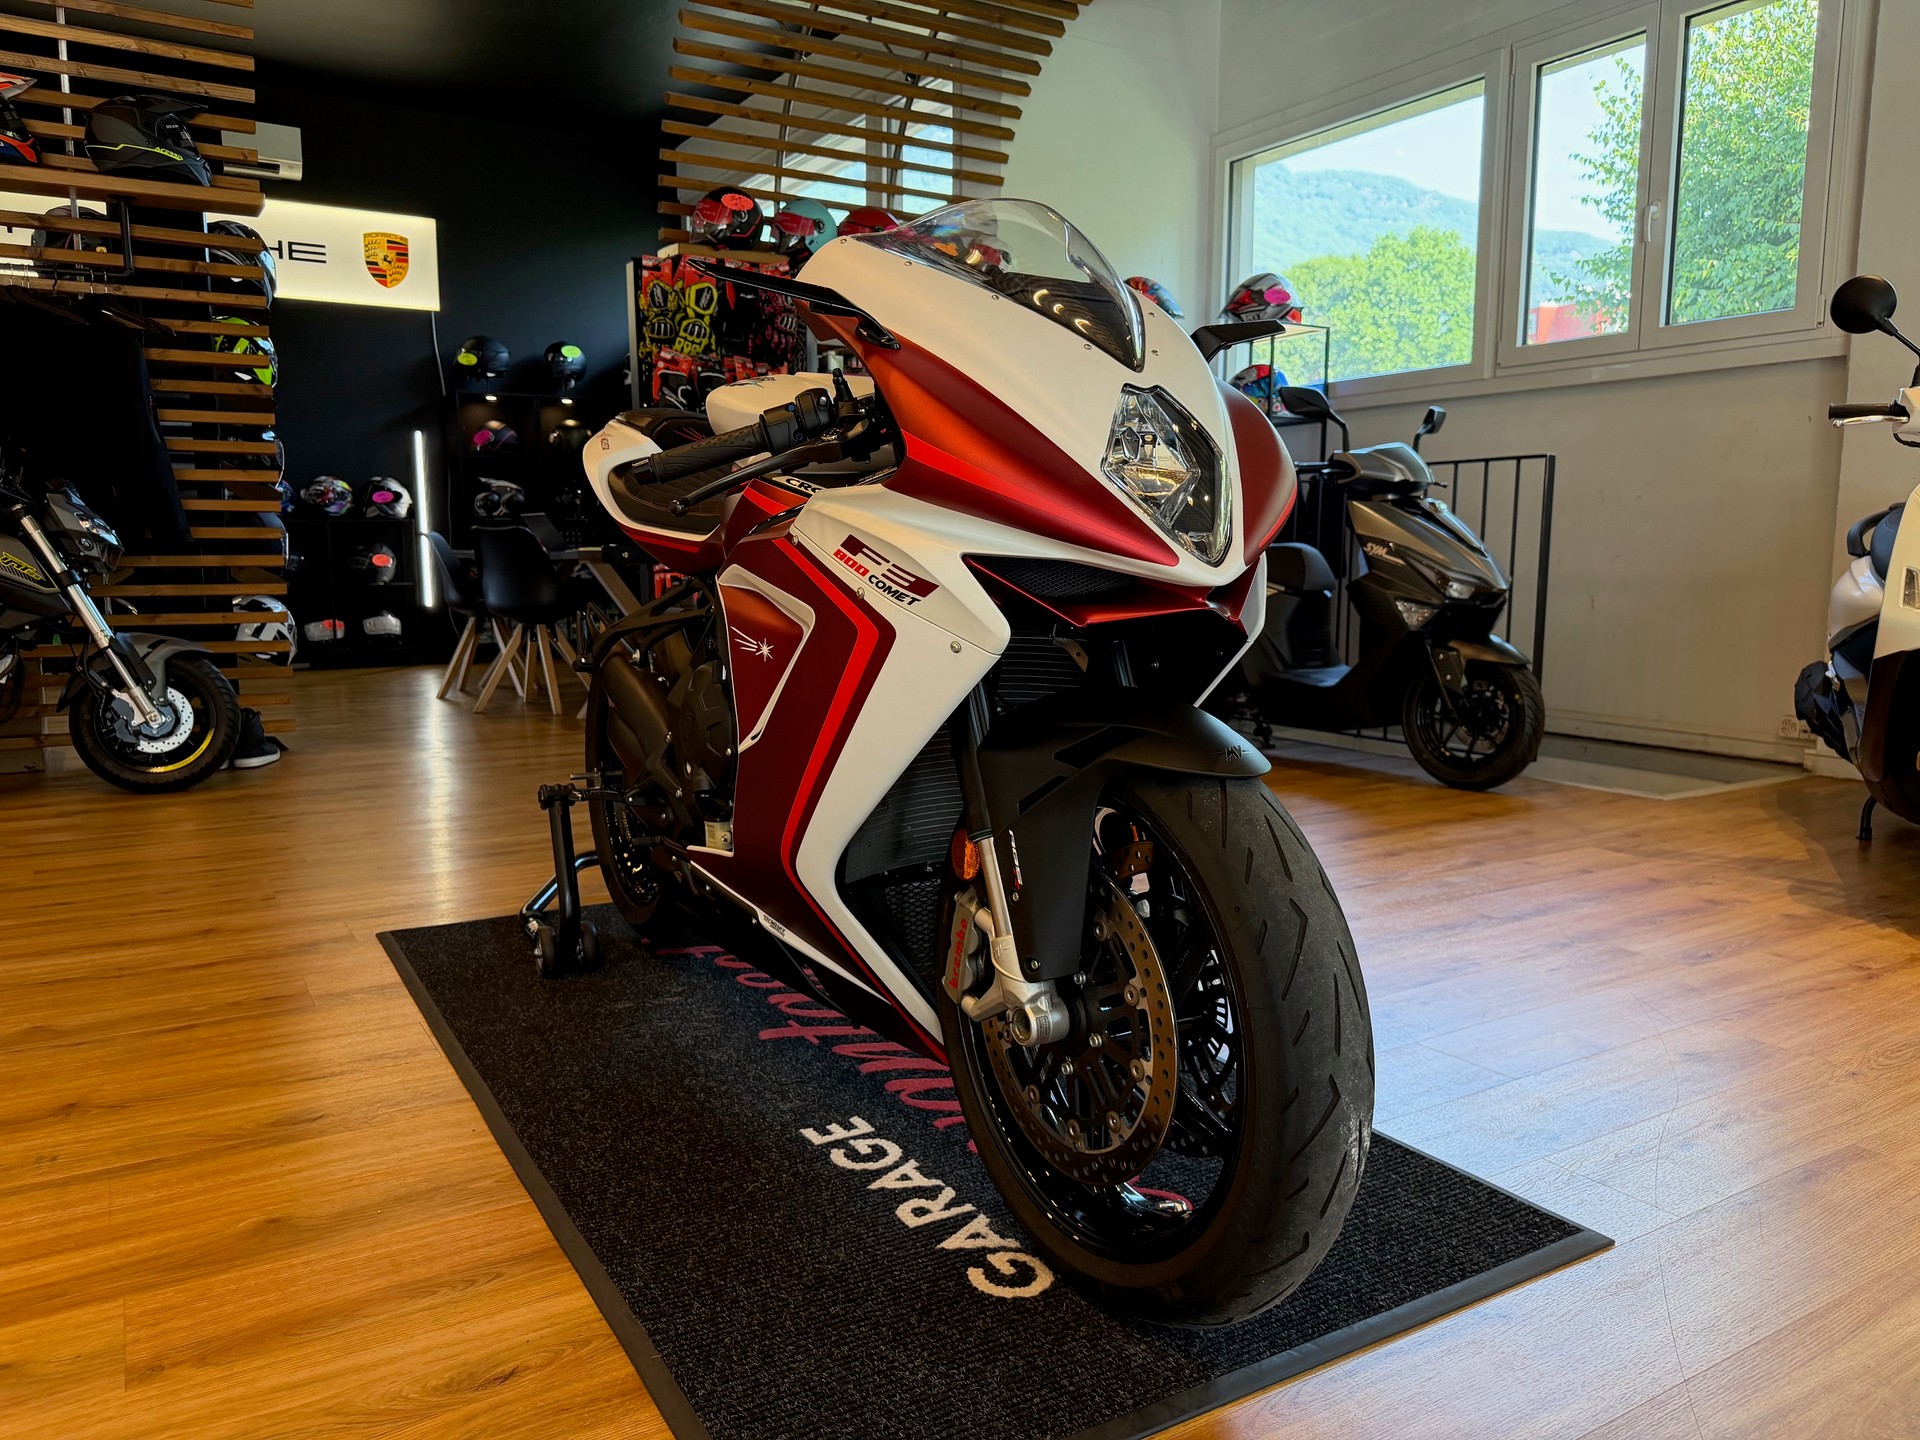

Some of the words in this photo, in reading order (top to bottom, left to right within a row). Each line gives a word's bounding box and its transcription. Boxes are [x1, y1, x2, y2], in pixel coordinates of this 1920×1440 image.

[833, 548, 870, 577] 800
[868, 574, 922, 606] COMET
[1362, 542, 1388, 556] SYM
[949, 917, 968, 990] brembo
[800, 1115, 1055, 1299] GARAGE
